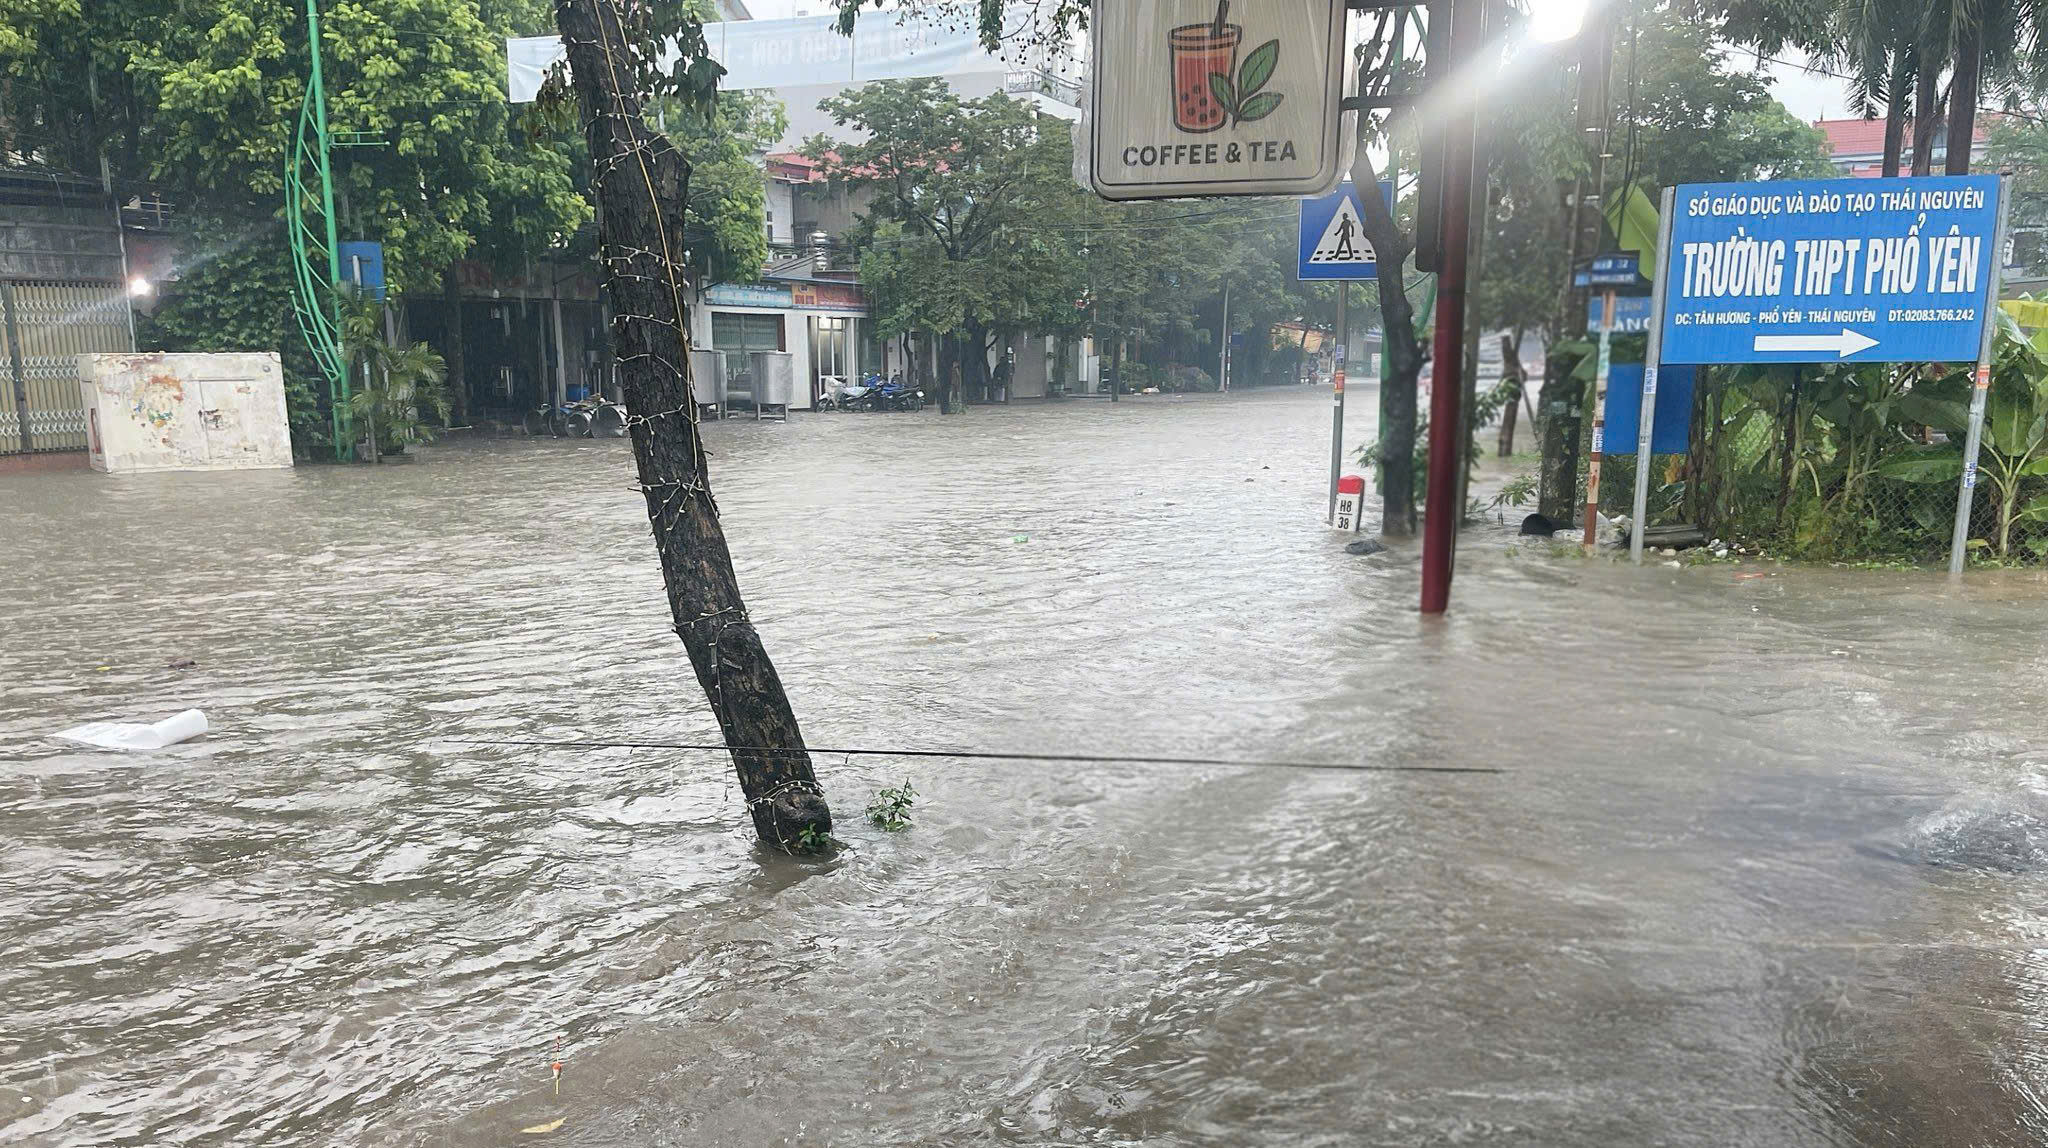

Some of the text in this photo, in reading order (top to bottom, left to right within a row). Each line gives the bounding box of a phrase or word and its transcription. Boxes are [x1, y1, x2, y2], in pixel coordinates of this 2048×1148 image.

[1122, 140, 1297, 167] COFFEE & TEA
[1688, 186, 1985, 220] SỞ GIÁO DỤC VÀ ĐÀO TẠO THÁI NGUYÊN
[1682, 212, 1981, 297] TRƯỜNG THPT PHỔ YÊN
[1695, 310, 1715, 325] TÂN
[1715, 311, 1751, 325] HƯƠNG
[1758, 304, 1780, 324] PHỔ
[1781, 308, 1802, 324] YÊN
[1808, 307, 1832, 323] THÁI
[1833, 307, 1876, 323] NGUYÊN
[1337, 517, 1350, 529] 38
